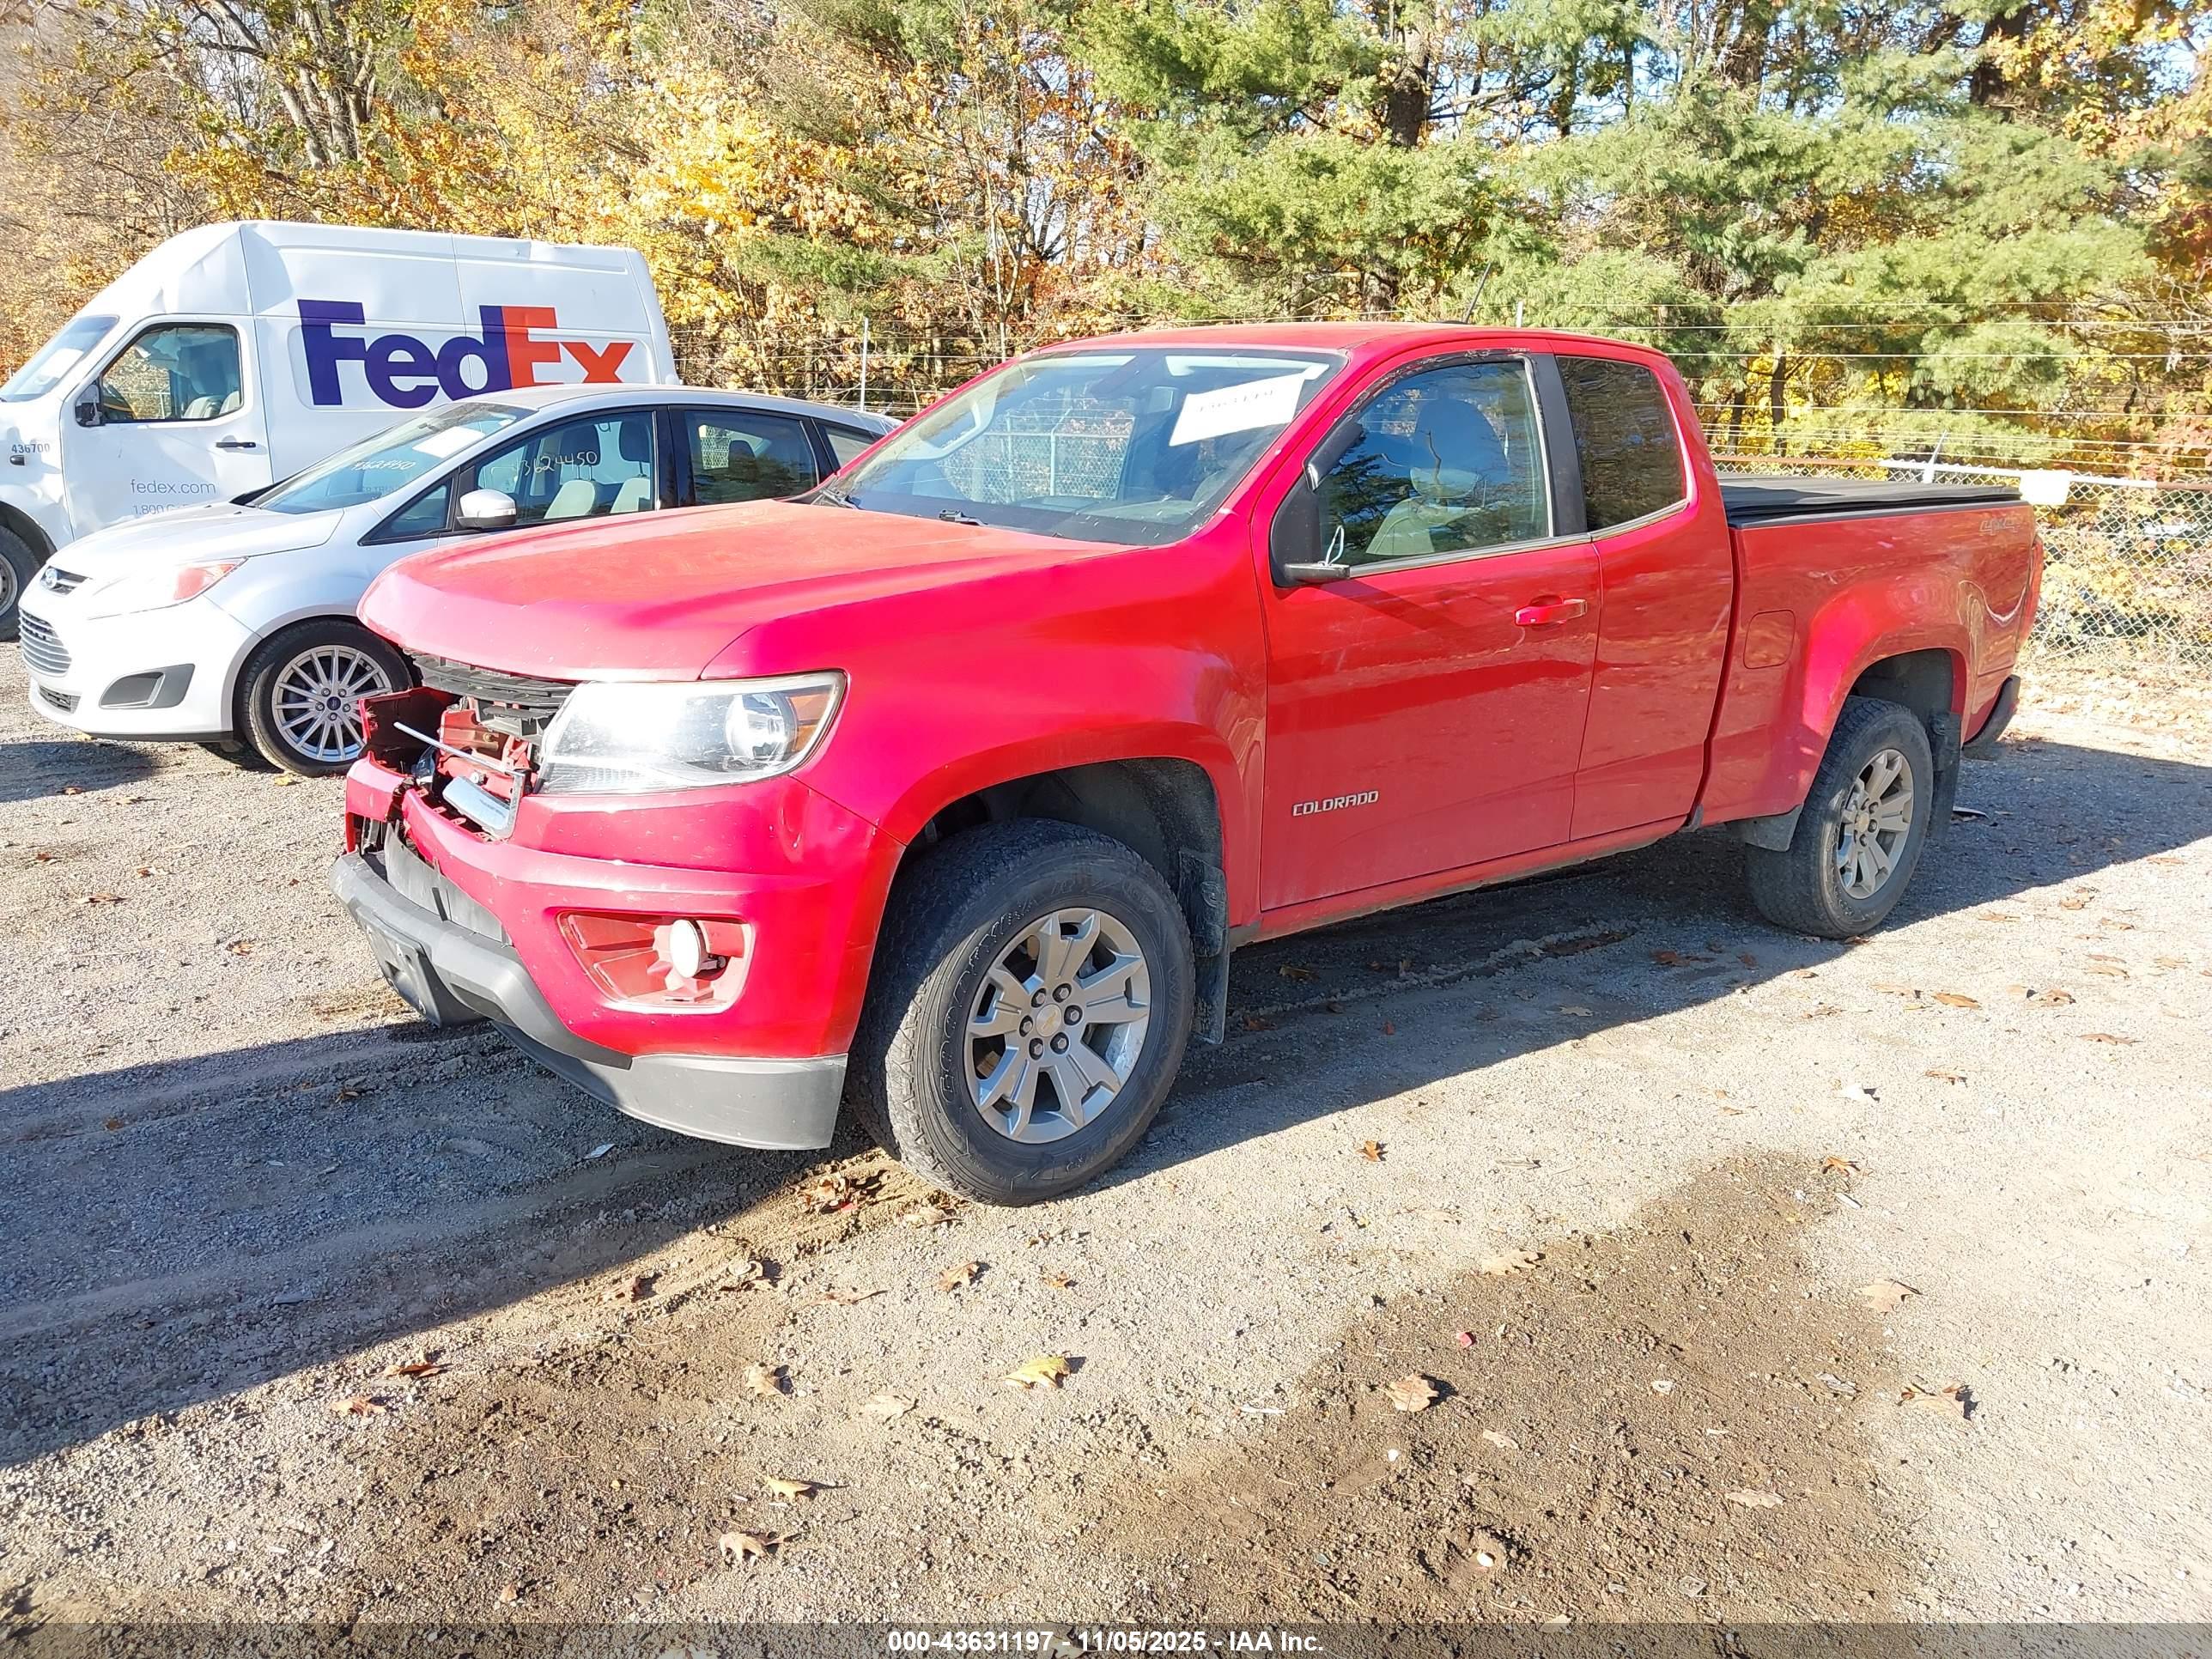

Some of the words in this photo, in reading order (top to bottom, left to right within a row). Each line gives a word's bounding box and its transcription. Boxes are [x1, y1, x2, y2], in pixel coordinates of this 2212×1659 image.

[297, 299, 635, 409] FedEx
[11, 443, 50, 453] 436700
[131, 478, 216, 495] fedex.com
[1292, 790, 1379, 817] COLORADO
